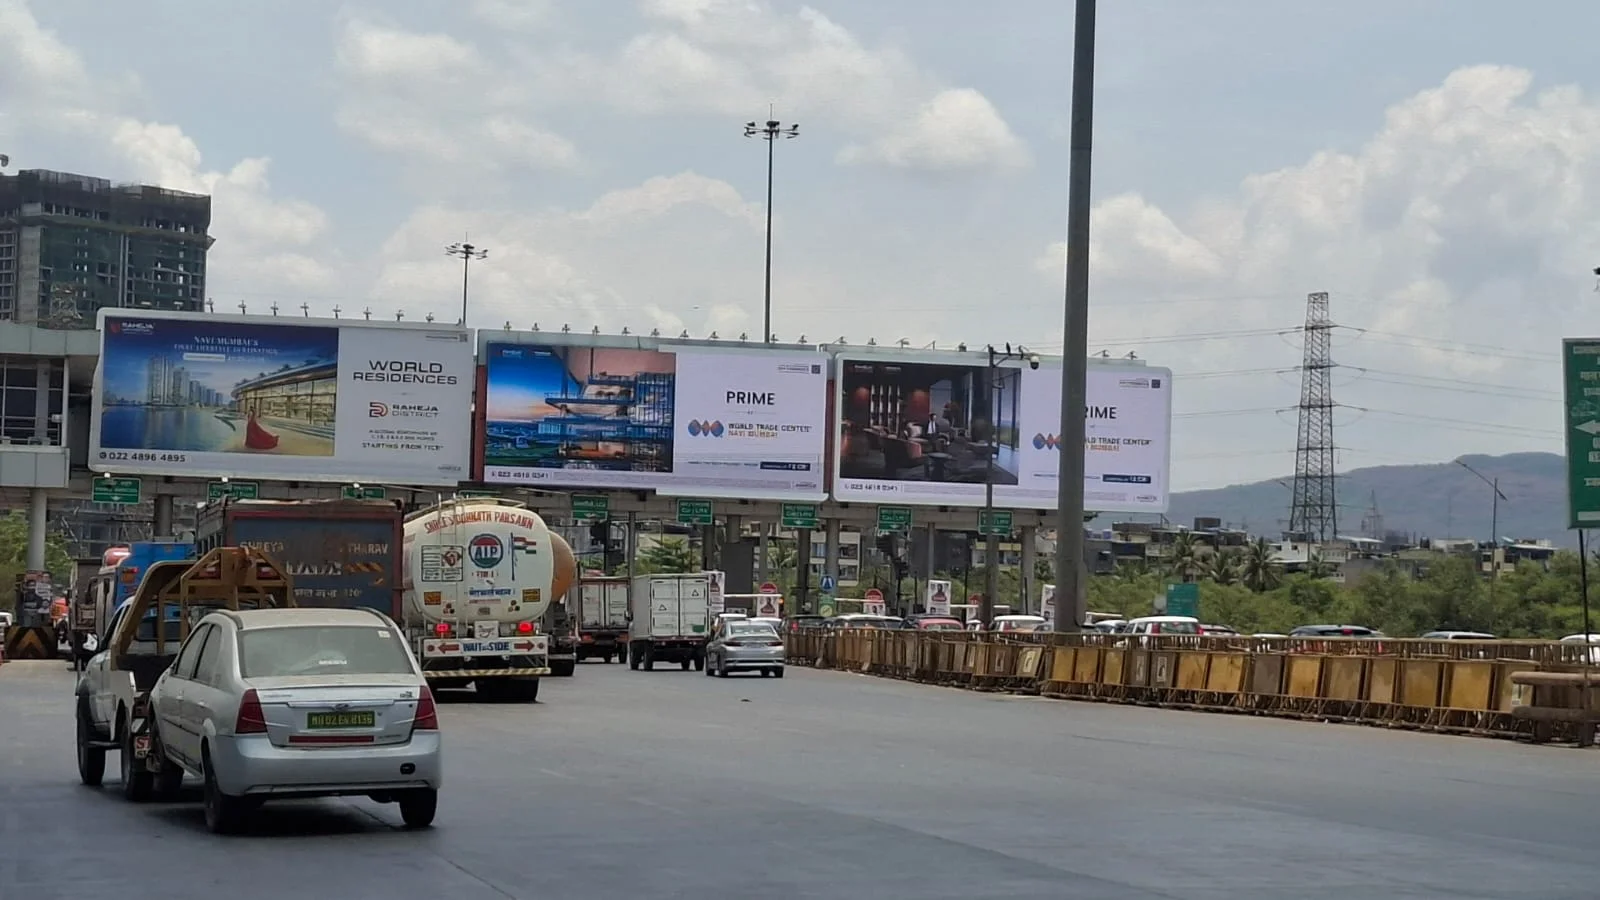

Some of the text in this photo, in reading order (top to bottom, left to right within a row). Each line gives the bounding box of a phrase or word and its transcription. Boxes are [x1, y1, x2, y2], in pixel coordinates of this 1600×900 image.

[368, 360, 443, 374] WORLD
[353, 372, 458, 385] RESIDENCES
[726, 391, 776, 405] PRIME
[392, 404, 438, 412] RAHEJA
[1084, 406, 1117, 419] IME
[756, 423, 778, 431] TRADE
[1099, 437, 1121, 445] TRADE
[109, 452, 186, 462] 022 4896 4895
[463, 642, 482, 652] WAIT
[488, 641, 510, 651] SIDE
